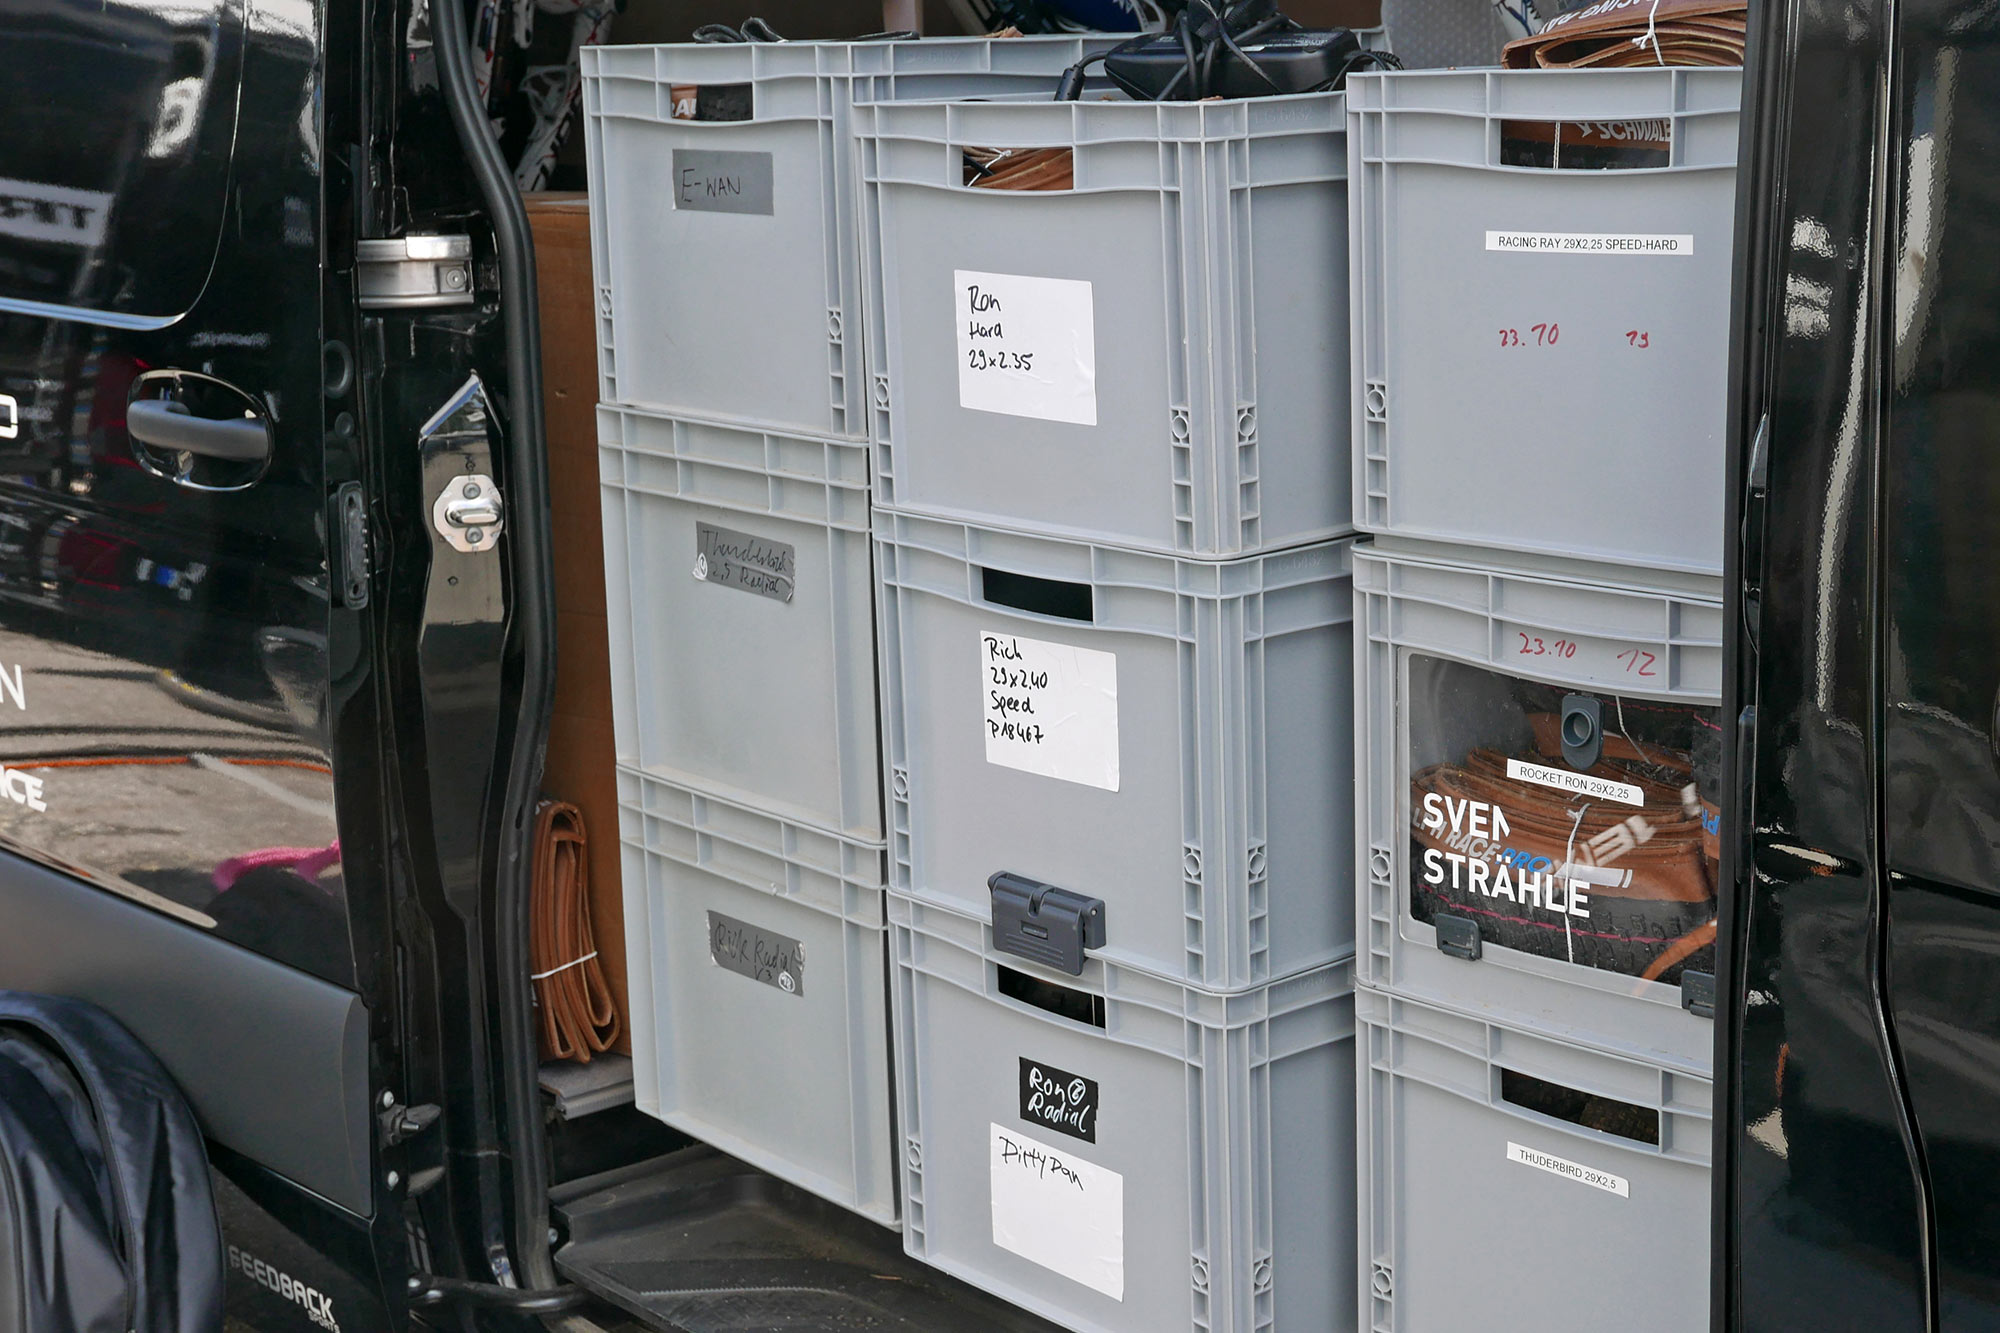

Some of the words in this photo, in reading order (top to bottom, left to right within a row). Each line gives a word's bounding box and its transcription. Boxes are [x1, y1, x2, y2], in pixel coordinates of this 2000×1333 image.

[682, 169, 740, 202] E-WAN
[1498, 236, 1537, 248] RACING
[1539, 238, 1561, 249] RAY
[1563, 239, 1603, 251] 29X2,25
[1605, 239, 1678, 251] SPEED-HARD
[968, 285, 1001, 314] Ron
[968, 349, 1033, 371] 29x2.35
[991, 690, 1035, 719] Speed
[1520, 766, 1562, 785] ROCKET
[1565, 776, 1588, 790] RON
[1590, 782, 1630, 800] 29X2,25
[1495, 847, 1552, 873] PRO
[1423, 848, 1590, 918] STRÄHLE
[1029, 1067, 1065, 1102] Ron
[1028, 1091, 1091, 1133] Radial
[1519, 1149, 1583, 1178] THUDERBIRD
[1584, 1171, 1617, 1190] 29X2,5
[228, 1244, 336, 1324] FEEDBACK
